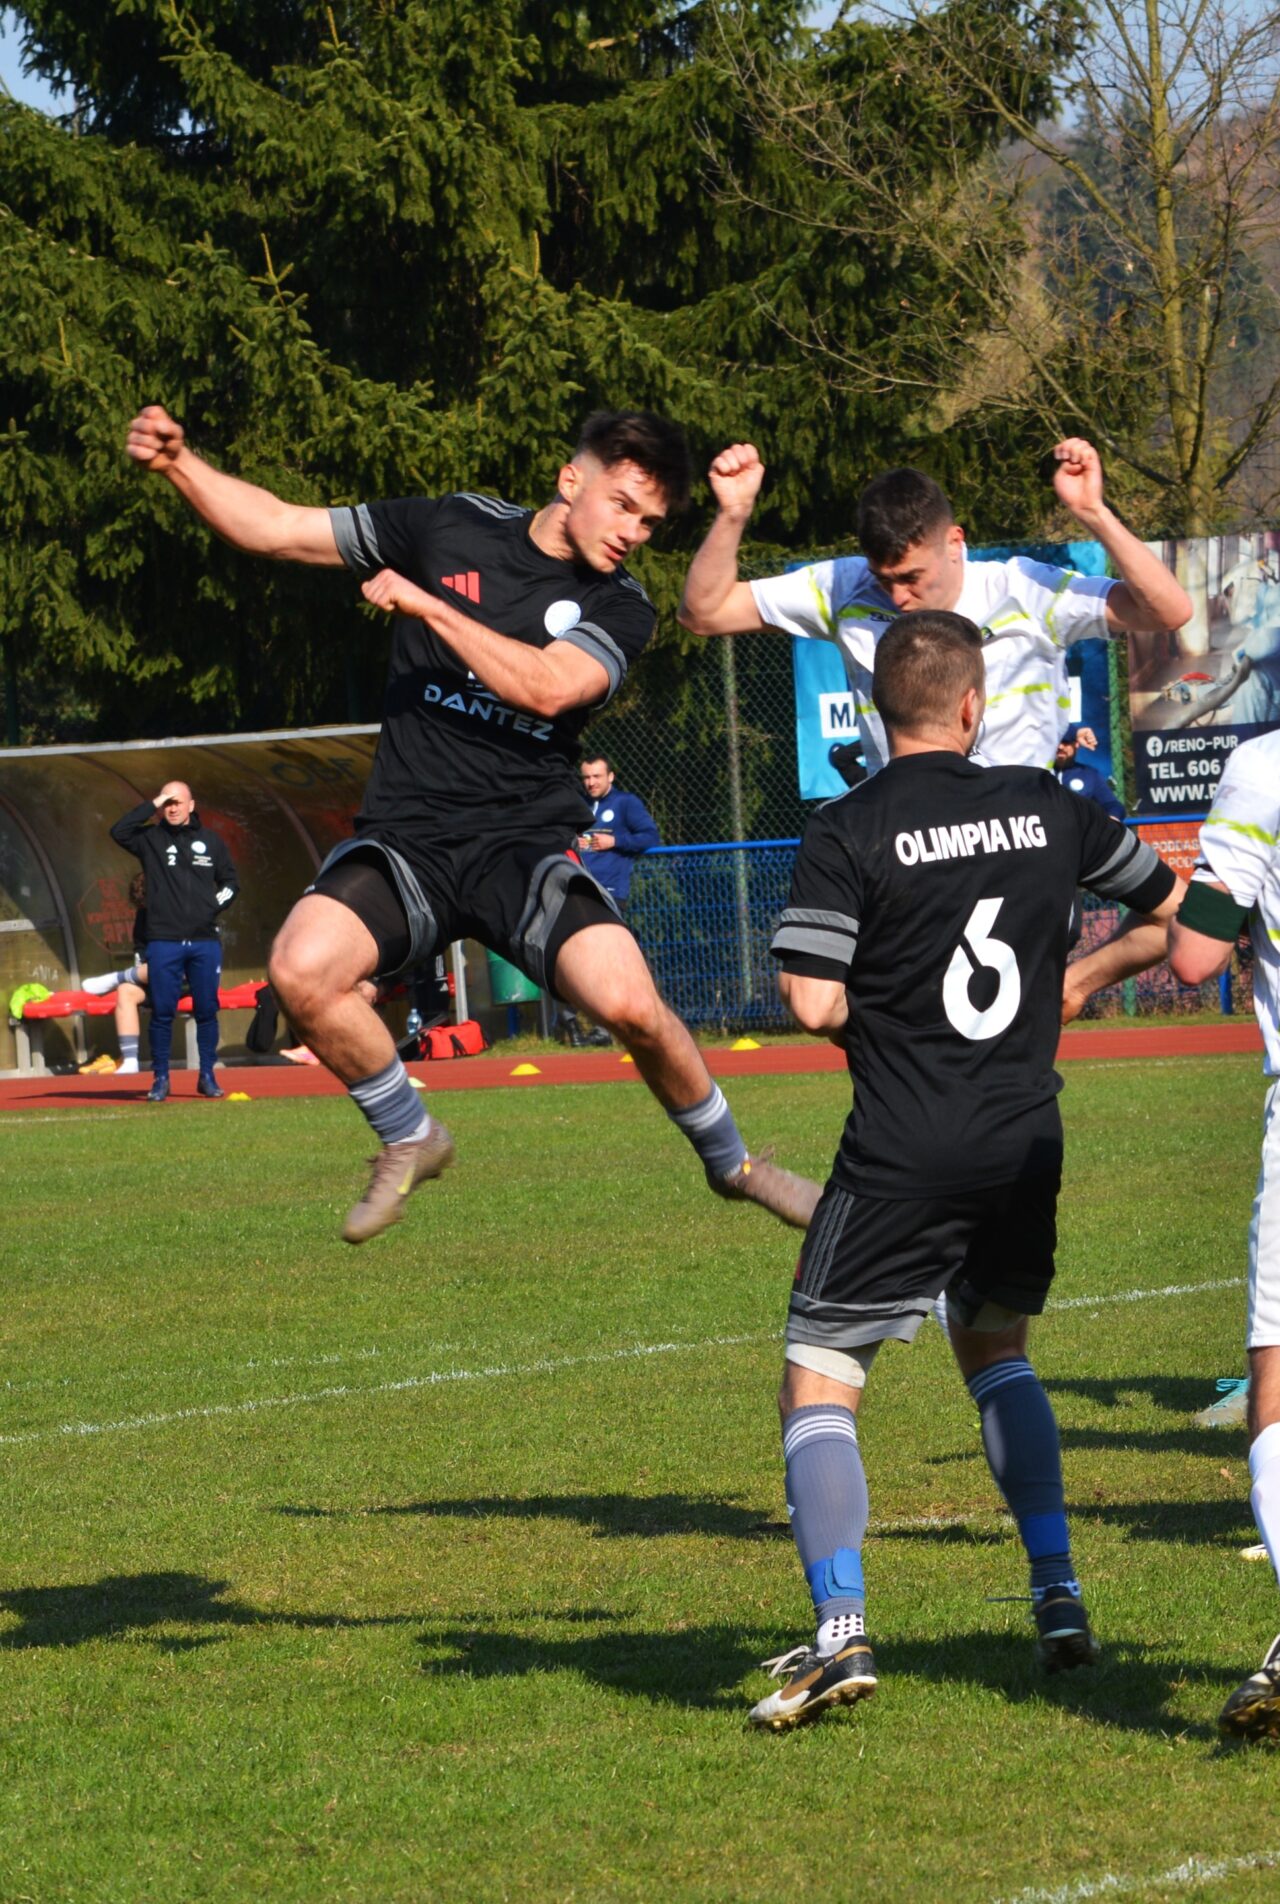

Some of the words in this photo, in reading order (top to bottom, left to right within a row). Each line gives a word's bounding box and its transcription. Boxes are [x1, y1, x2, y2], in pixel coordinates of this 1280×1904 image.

[423, 683, 555, 742] DANTEZ
[1147, 761, 1185, 780] TEL.
[1187, 758, 1221, 777] 606
[895, 818, 1011, 867] OLIMPIA
[1008, 815, 1048, 850] KG
[942, 896, 1022, 1041] 6
